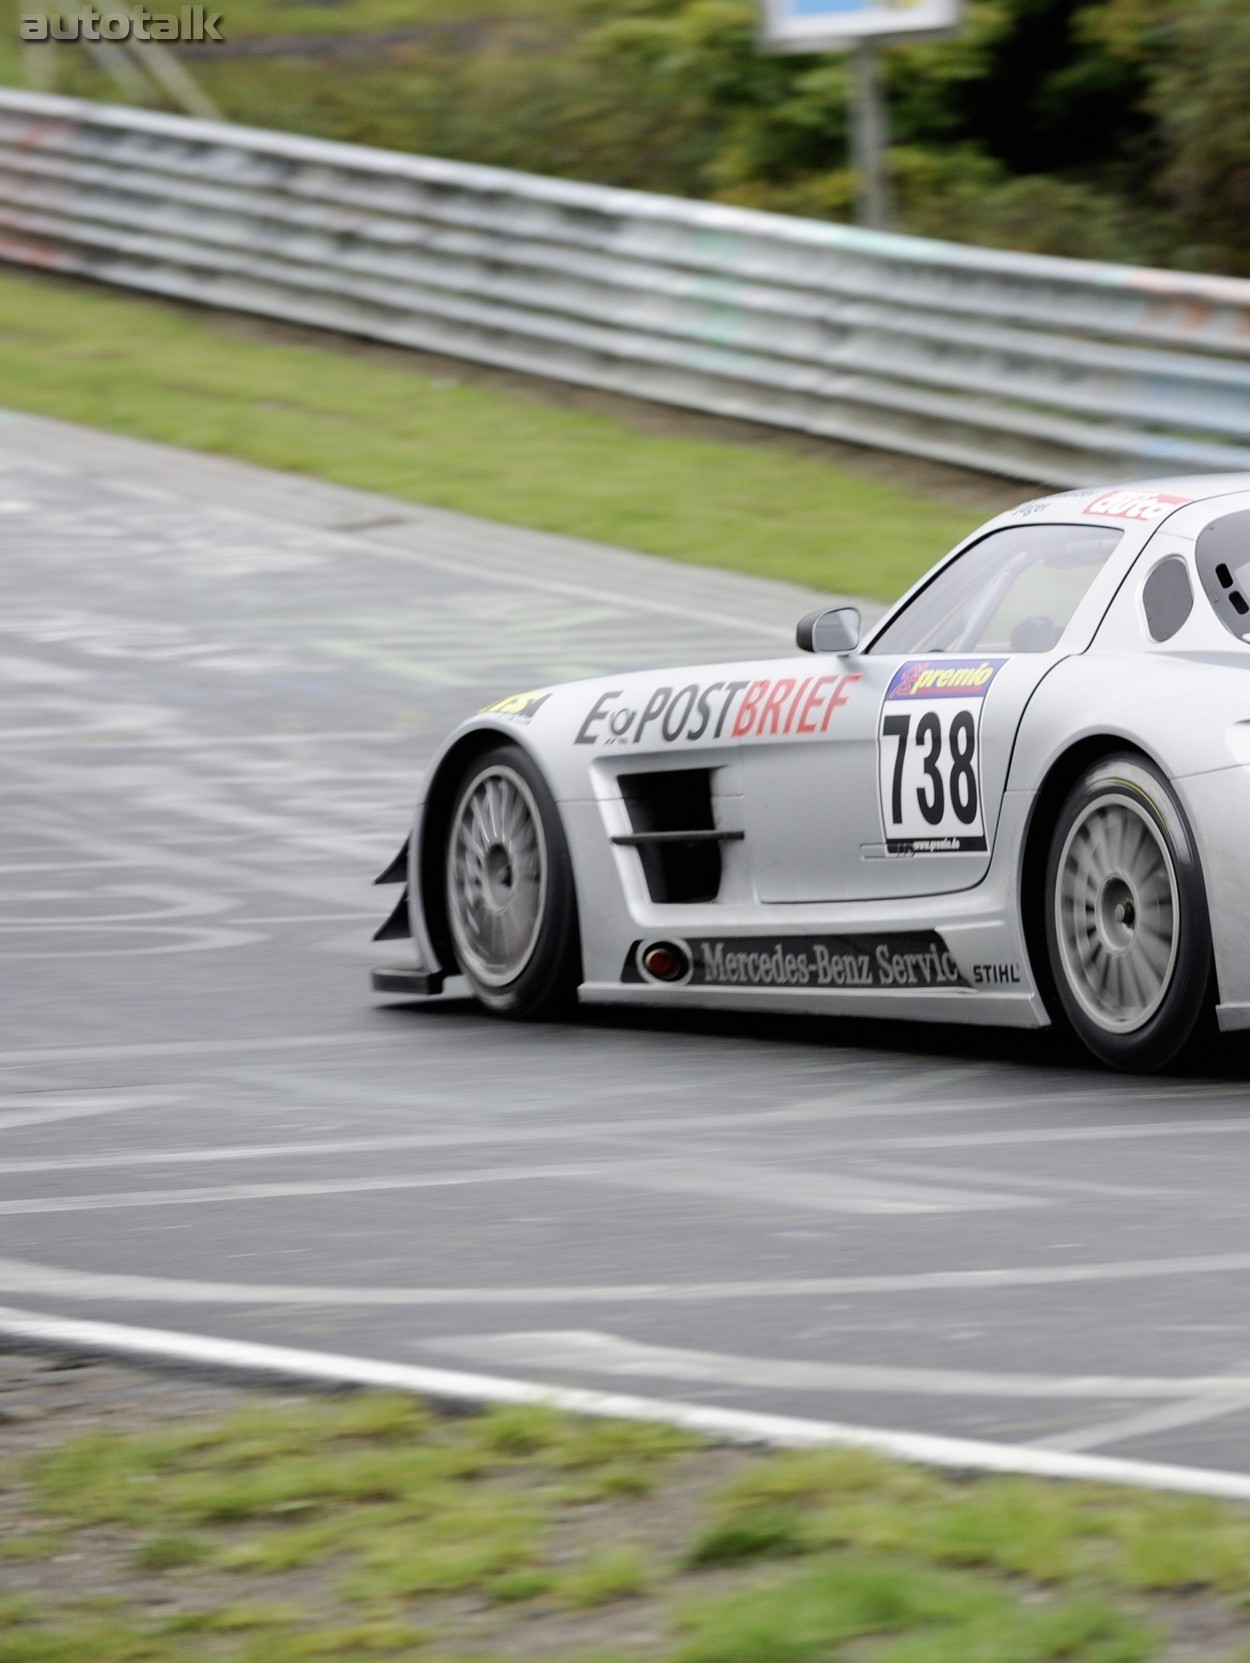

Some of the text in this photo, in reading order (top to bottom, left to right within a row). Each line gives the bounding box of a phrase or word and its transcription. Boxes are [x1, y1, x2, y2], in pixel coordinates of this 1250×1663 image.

[910, 662, 994, 695] premio
[883, 710, 978, 825] 738
[700, 941, 874, 985] Mercedes-Benz
[973, 964, 1021, 984] STIHL
